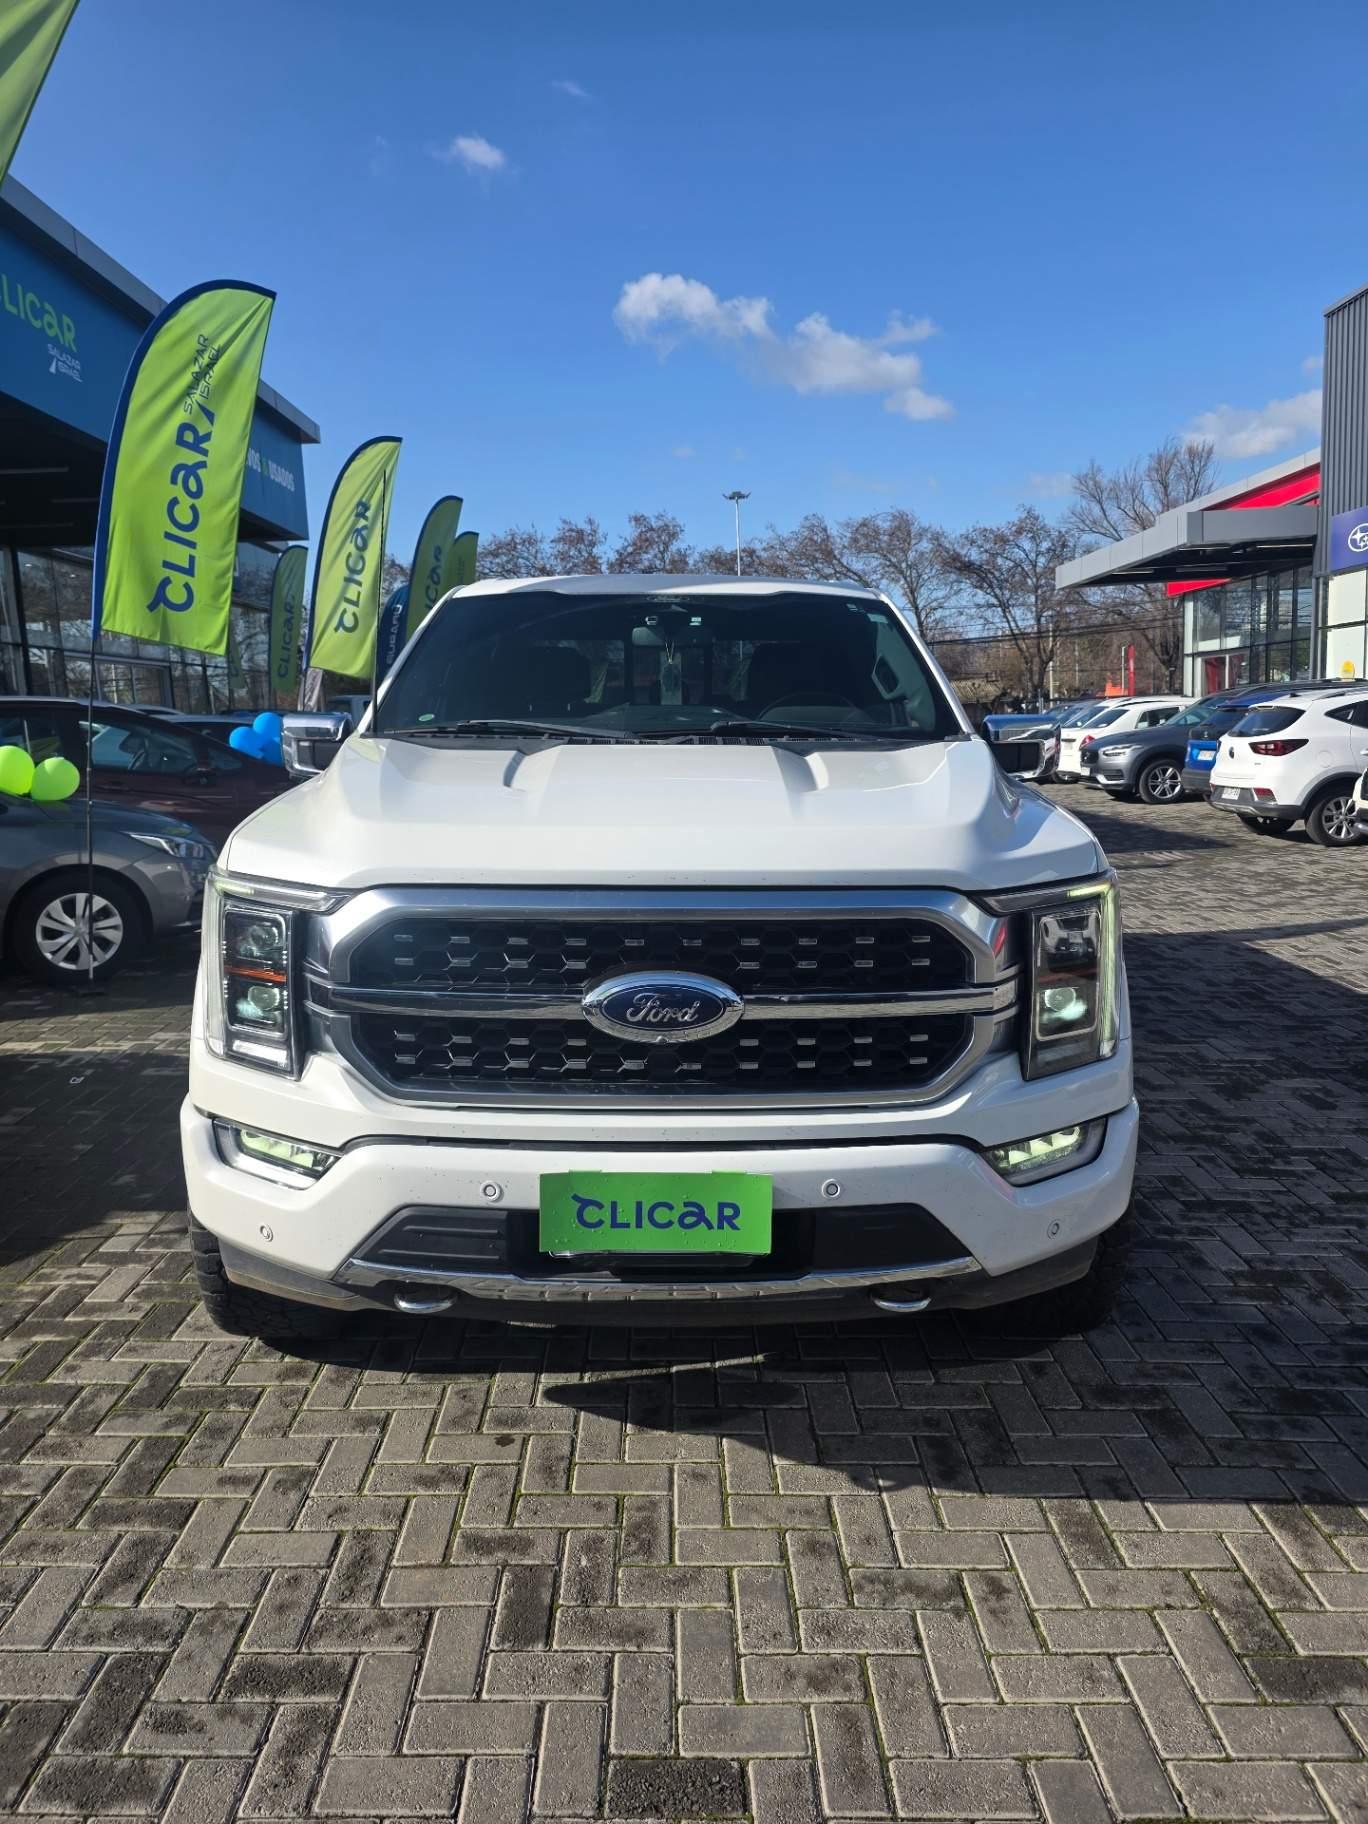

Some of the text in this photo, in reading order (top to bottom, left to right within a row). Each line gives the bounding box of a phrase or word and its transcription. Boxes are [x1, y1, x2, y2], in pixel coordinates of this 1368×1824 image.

[183, 334, 209, 415] SALAZAR
[199, 345, 221, 399] ISRAEL
[386, 603, 403, 664] SUBARU
[626, 992, 700, 1023] Ford
